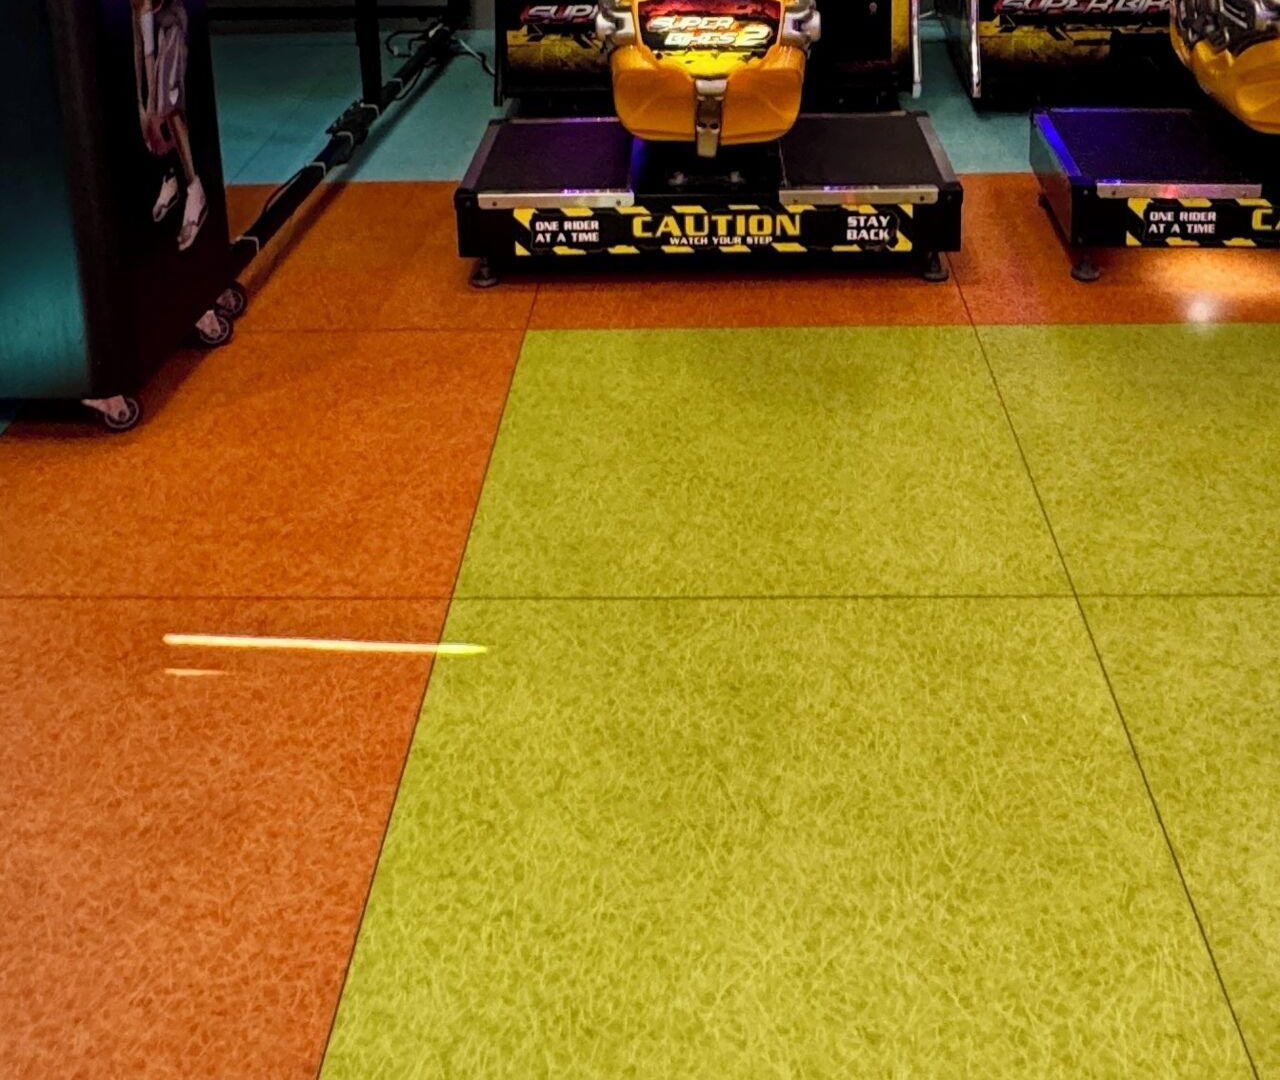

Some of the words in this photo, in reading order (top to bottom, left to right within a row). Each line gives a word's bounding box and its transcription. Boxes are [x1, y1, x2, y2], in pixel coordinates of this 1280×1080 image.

[650, 16, 736, 31] SUPER
[737, 24, 773, 47] 2
[847, 215, 890, 227] STAY
[1149, 211, 1174, 222] ONE
[1179, 211, 1217, 222] RIDER
[535, 221, 559, 231] ONE
[564, 220, 599, 231] RIDER
[632, 214, 801, 238] CAUTION
[1148, 223, 1166, 233] AT
[1170, 223, 1180, 233] A
[1186, 223, 1216, 233] TIME
[535, 233, 552, 243] AT
[557, 233, 566, 243] A
[571, 232, 599, 242] TIME
[847, 228, 890, 240] BACK
[669, 236, 709, 245] WATCH
[712, 236, 742, 245] YOUR
[746, 235, 773, 245] STEP
